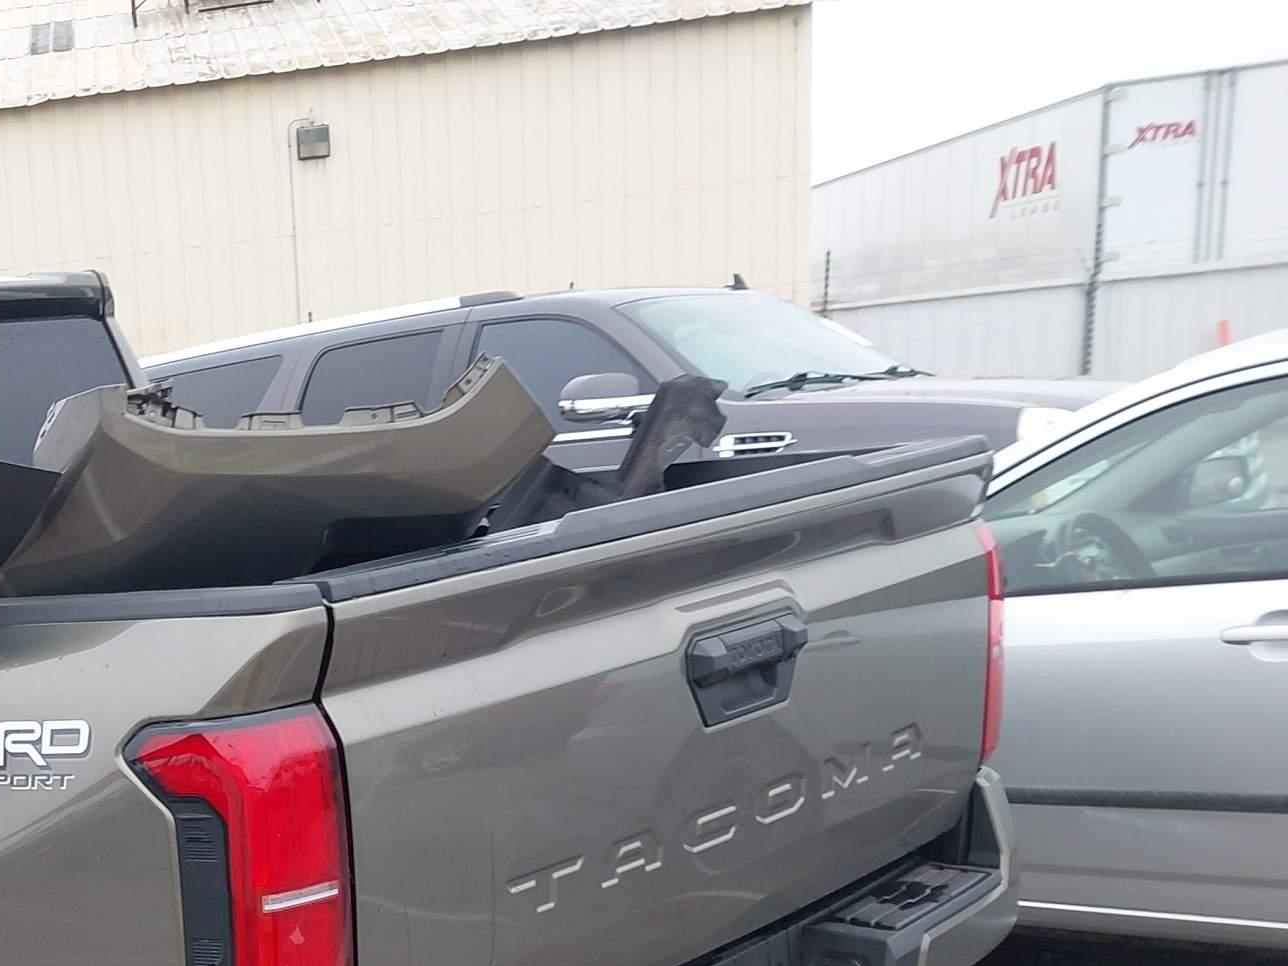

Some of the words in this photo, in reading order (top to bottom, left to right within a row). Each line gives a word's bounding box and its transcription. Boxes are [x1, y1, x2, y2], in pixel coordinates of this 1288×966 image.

[1128, 120, 1197, 149] XTRA
[989, 141, 1057, 219] XTRA
[506, 722, 923, 913] TACOMA
